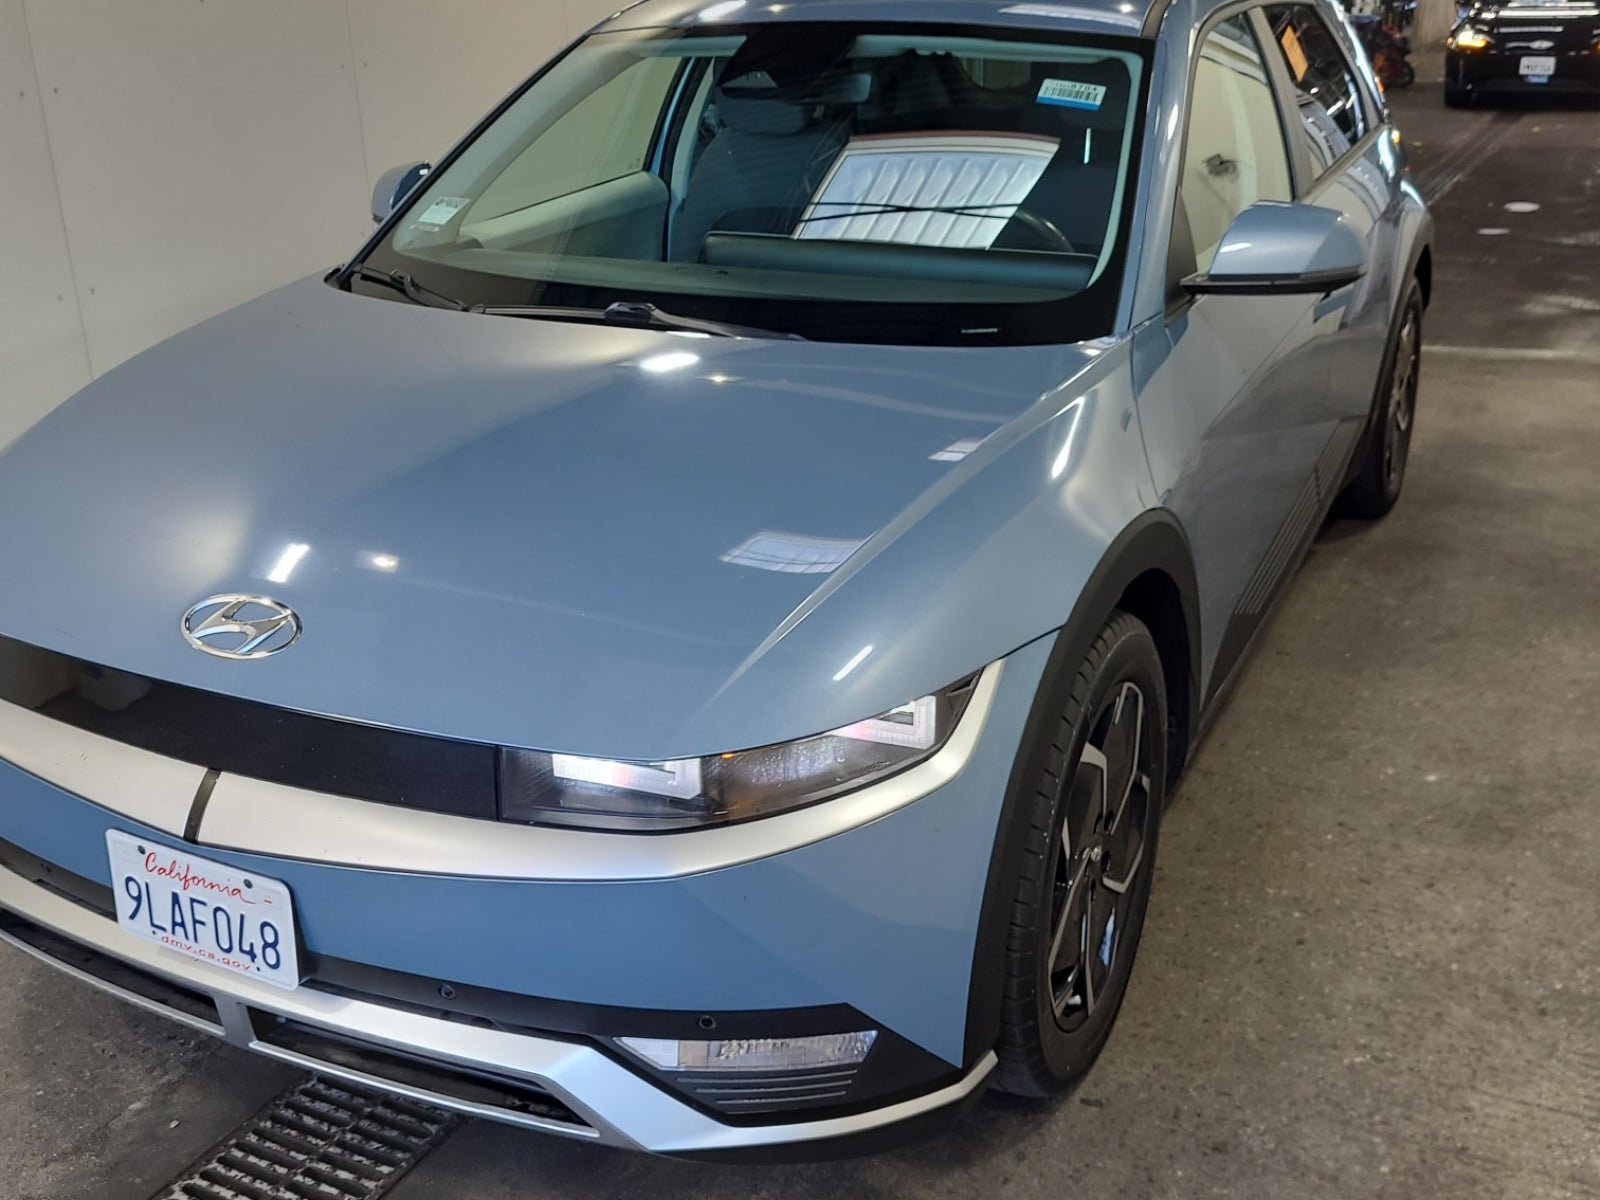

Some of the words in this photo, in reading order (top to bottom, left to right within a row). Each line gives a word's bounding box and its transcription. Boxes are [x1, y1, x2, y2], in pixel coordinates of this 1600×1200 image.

[145, 852, 256, 904] California
[125, 876, 280, 970] 9LAF048
[161, 934, 251, 971] dmv.ca.gov
